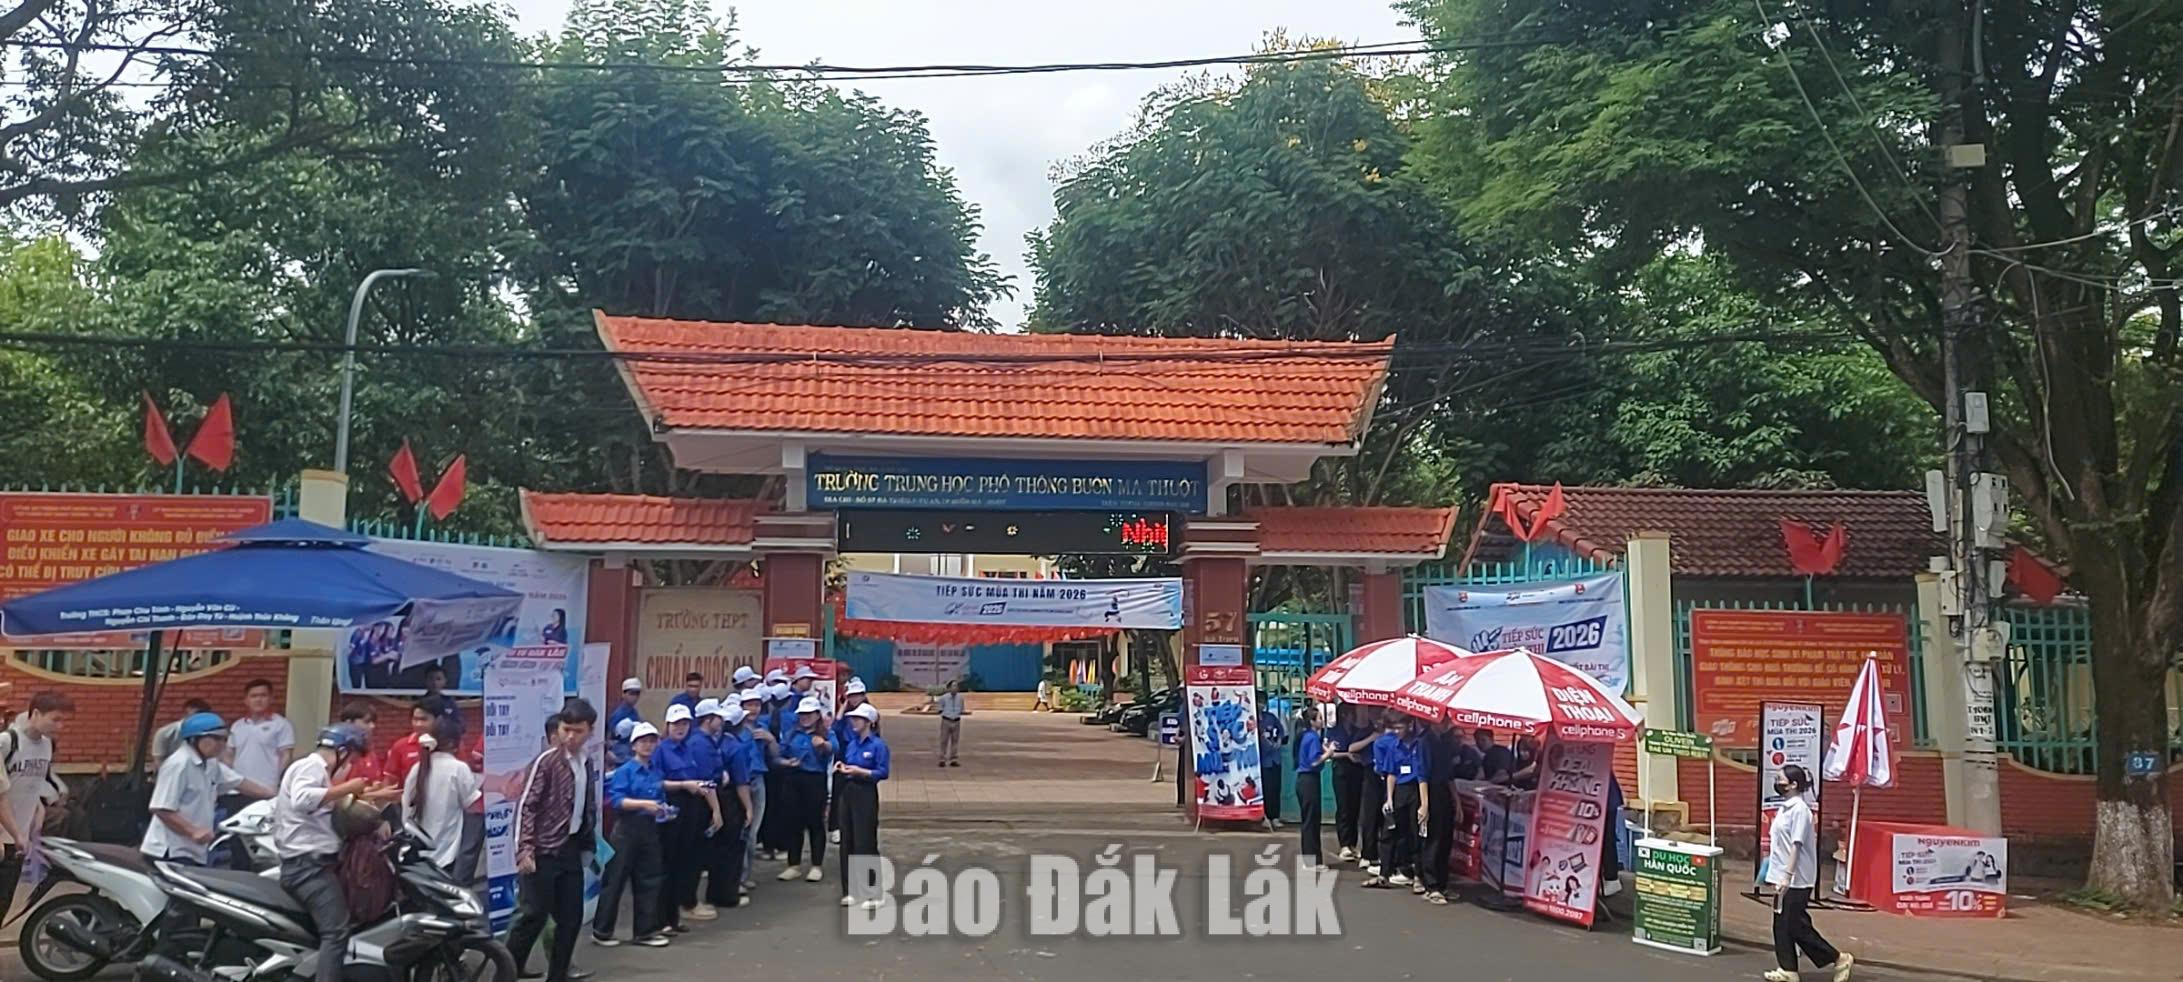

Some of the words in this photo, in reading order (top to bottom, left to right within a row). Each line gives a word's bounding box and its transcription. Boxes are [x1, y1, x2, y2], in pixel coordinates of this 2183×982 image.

[884, 474, 938, 492] TRUNG
[942, 475, 973, 495] HỌC
[1015, 474, 1067, 494] THÔNG
[1072, 475, 1112, 495] BUÔN
[1118, 479, 1142, 496] MA
[40, 529, 56, 542] XE
[59, 529, 85, 542] CHO
[81, 548, 97, 560] XE
[936, 584, 957, 596] TIẾP
[961, 584, 982, 597] SỨC
[986, 585, 1008, 598] MÙA
[1013, 587, 1028, 598] THI
[1033, 586, 1055, 599] NĂM
[1059, 589, 1086, 600] 2026
[656, 610, 709, 629] TRƯỜNG
[713, 613, 748, 630] THPT
[1205, 611, 1237, 631] 57
[1502, 626, 1524, 644] TIẾP
[1525, 625, 1545, 641] SỨC
[1553, 623, 1600, 649] 2026
[1799, 727, 1817, 735] 2026
[1652, 850, 1666, 861] DU
[1668, 853, 1690, 865] HỌC
[1644, 858, 1665, 871] HÀN
[1666, 862, 1697, 876] QUỐC
